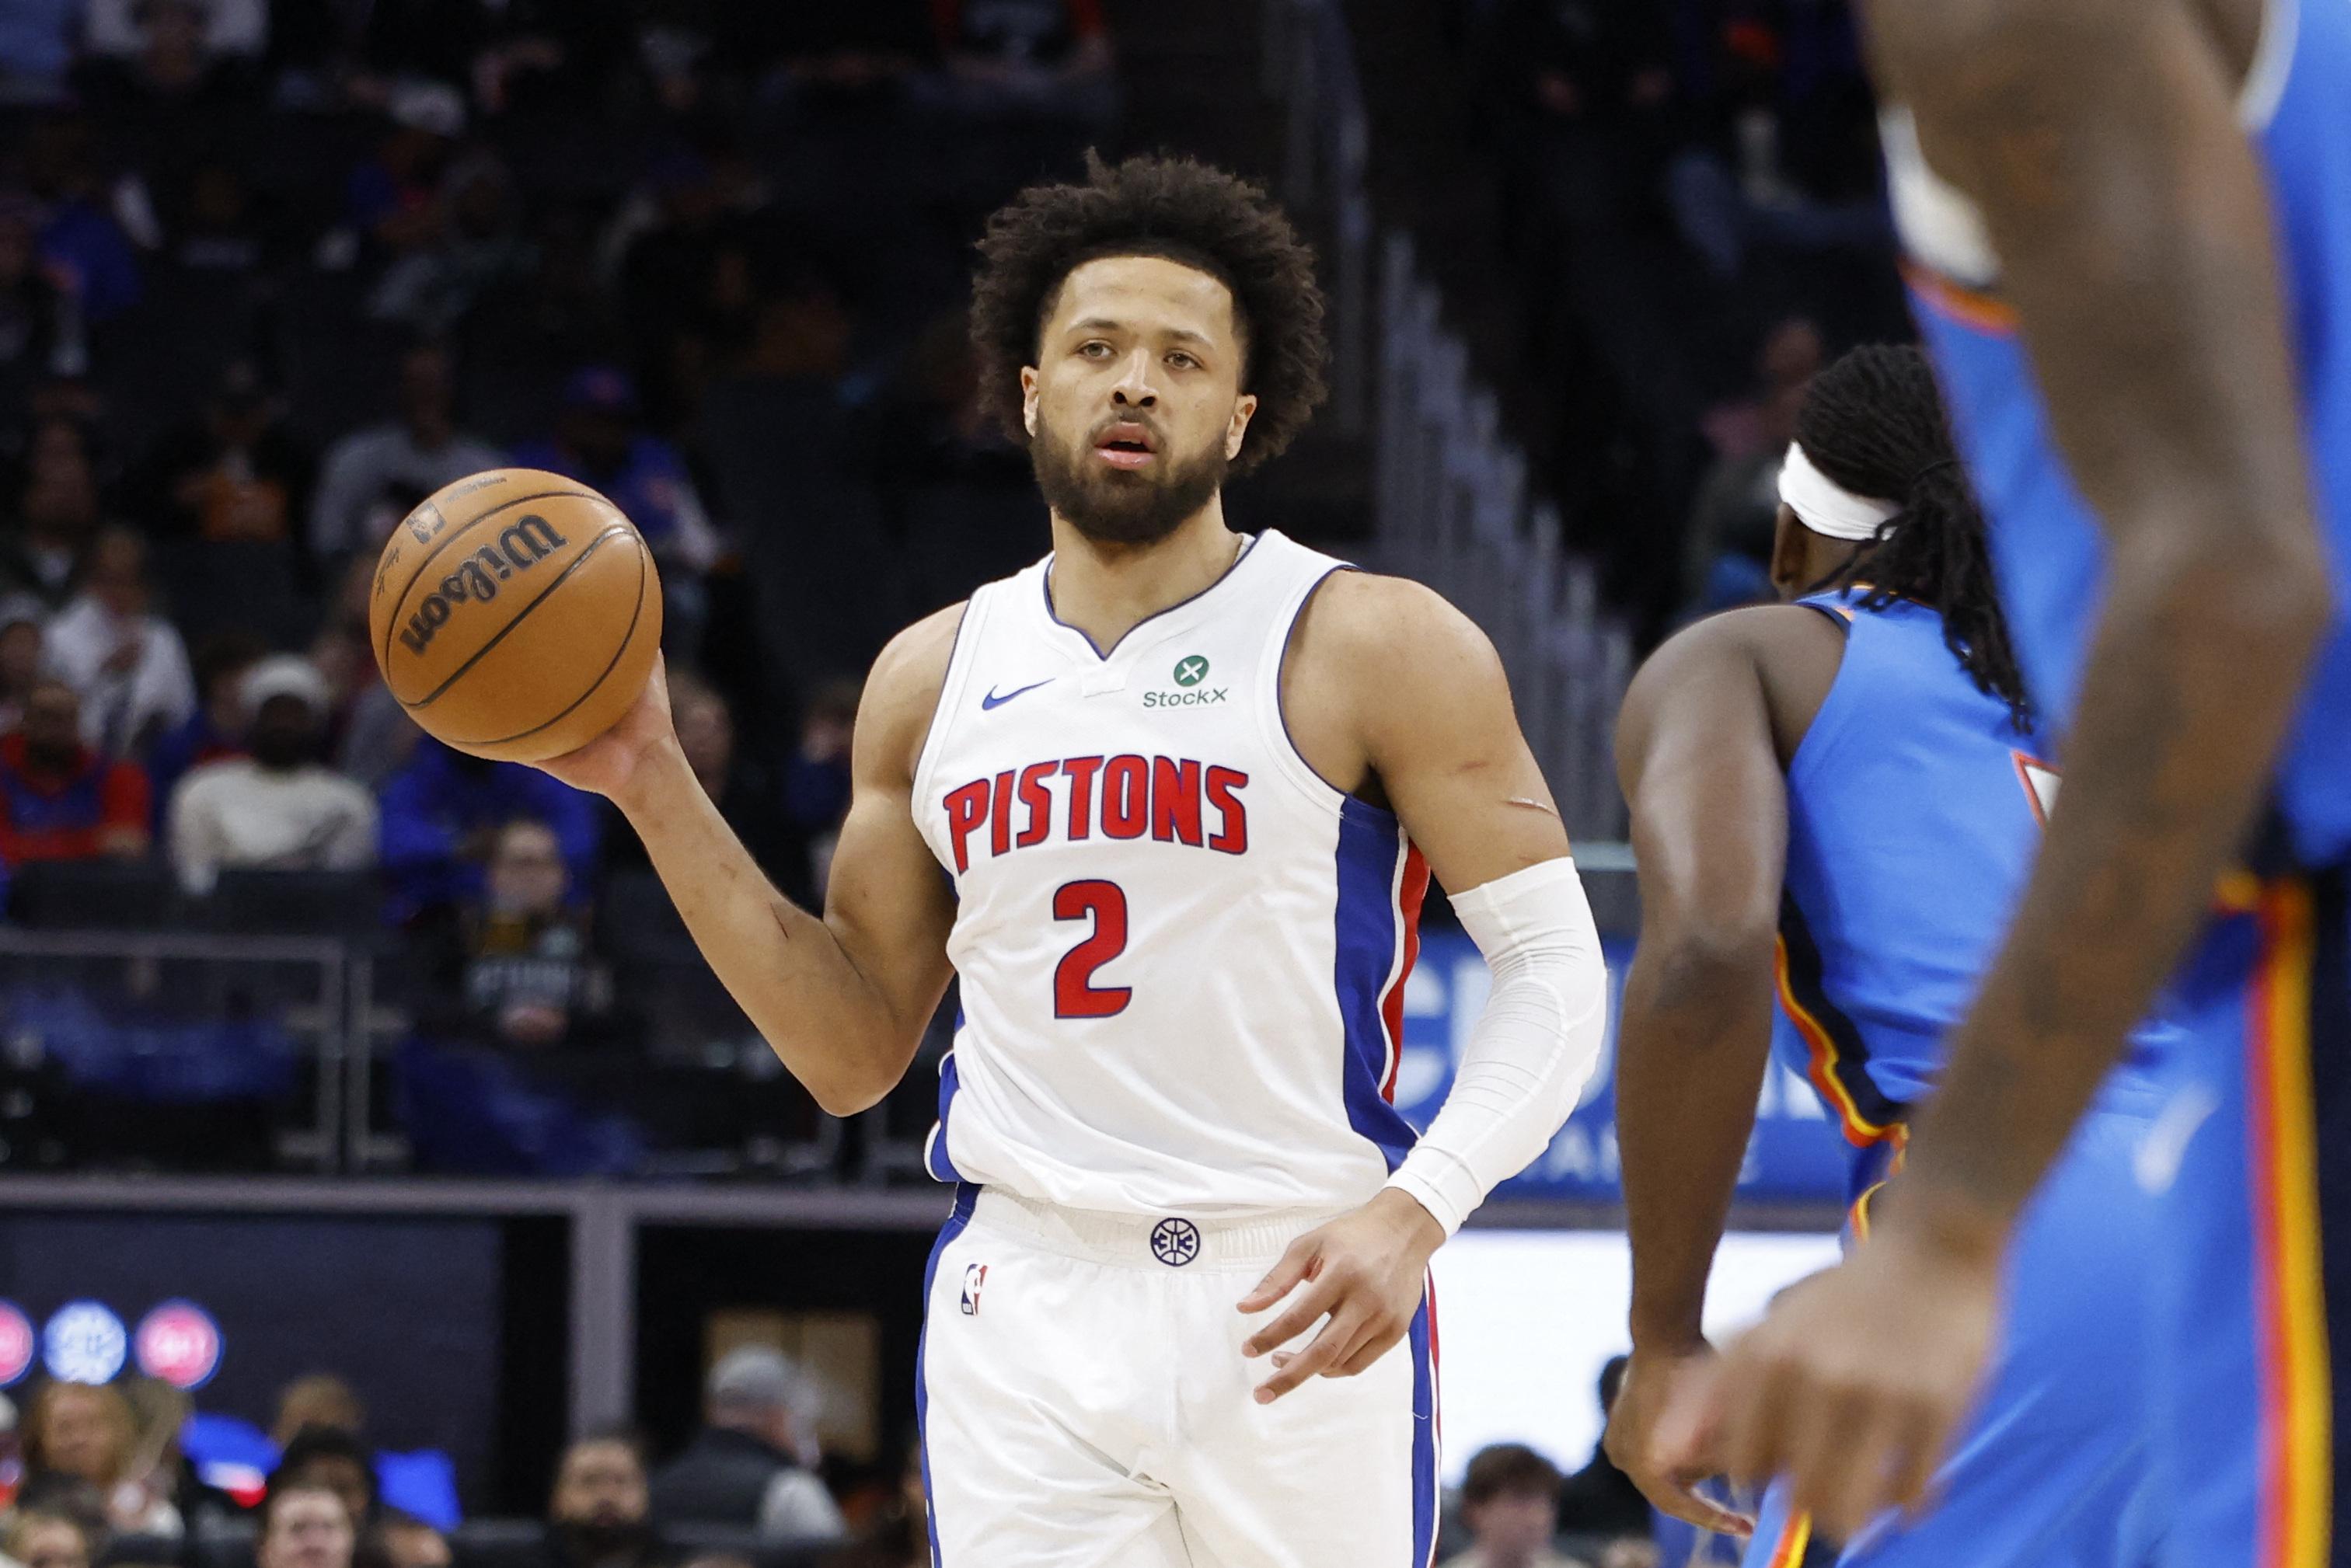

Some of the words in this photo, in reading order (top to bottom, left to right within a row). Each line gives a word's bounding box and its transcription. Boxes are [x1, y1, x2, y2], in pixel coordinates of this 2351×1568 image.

[399, 514, 569, 655] Wilson
[1142, 688, 1229, 708] StockX
[943, 754, 1249, 876] PISTONS
[1053, 879, 1132, 1019] 2
